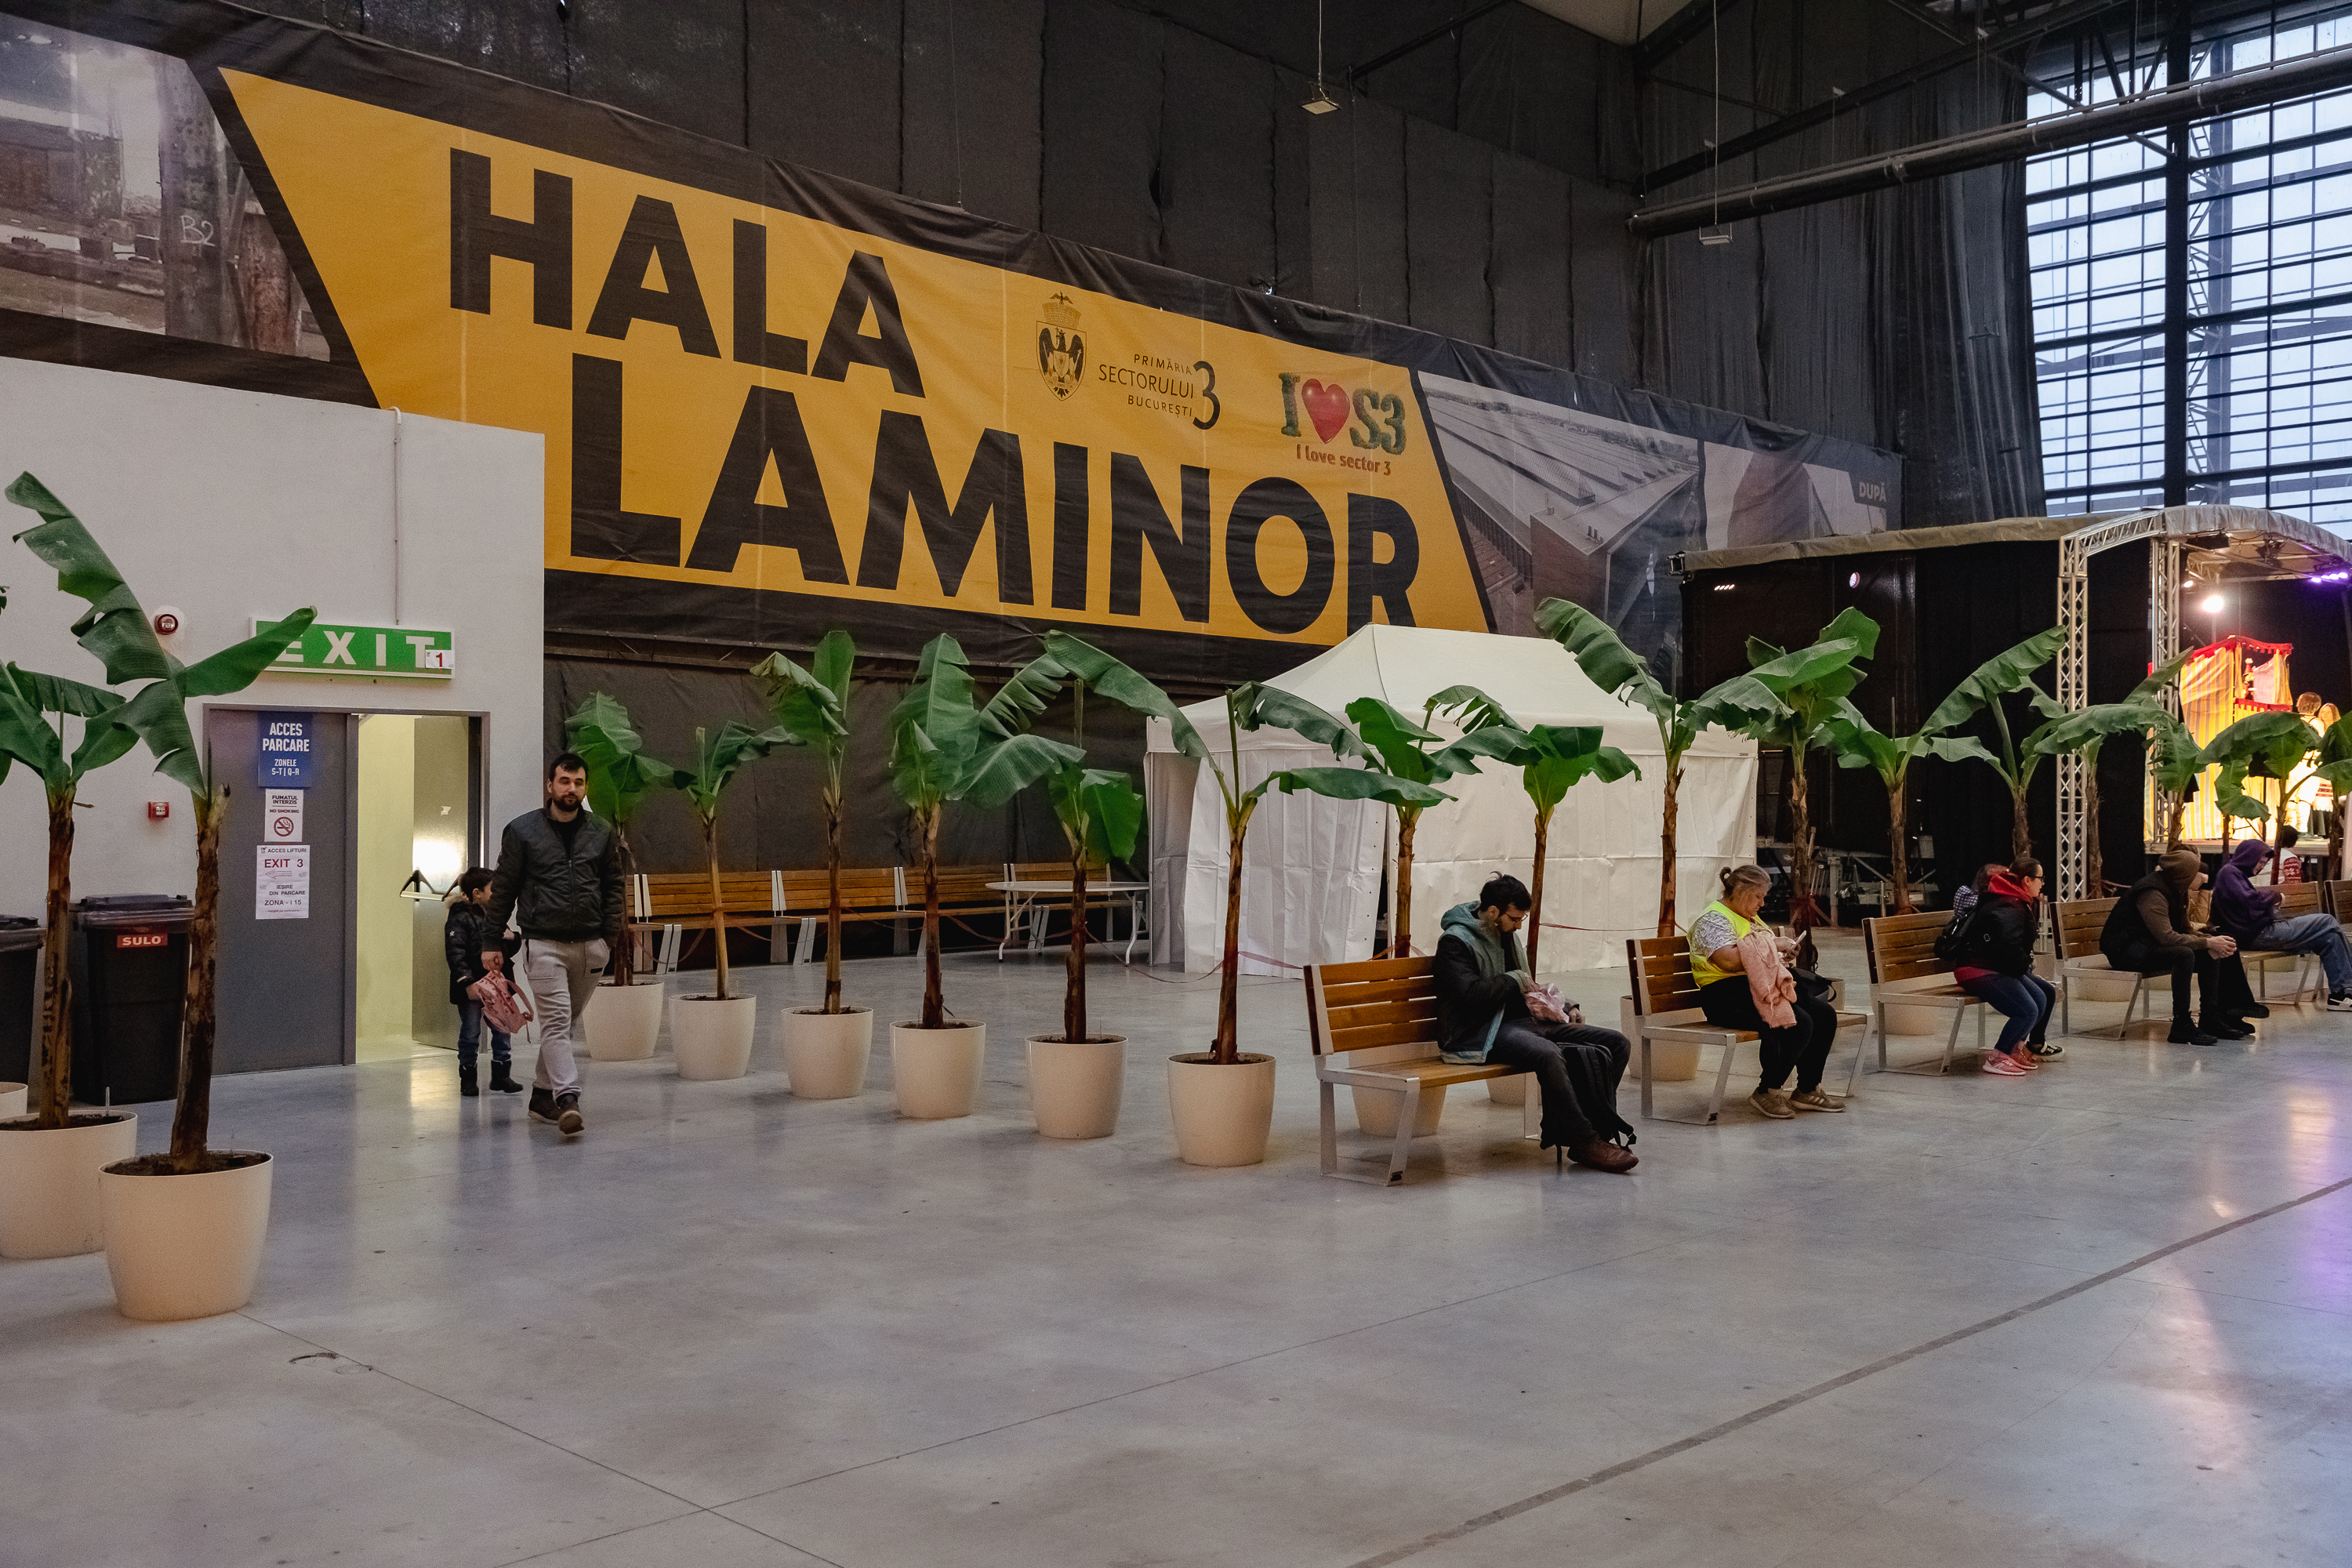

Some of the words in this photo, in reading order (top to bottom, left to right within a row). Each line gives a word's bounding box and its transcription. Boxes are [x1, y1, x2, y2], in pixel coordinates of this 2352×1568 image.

[180, 215, 216, 247] B2
[450, 147, 926, 399] HALA
[1134, 354, 1192, 376] PRIMĂRIA
[1098, 364, 1193, 399] SECTORULUI
[1192, 360, 1221, 430] 3
[1127, 394, 1192, 419] BUCUREȘTI
[1278, 372, 1302, 438] I
[1349, 388, 1406, 456] S3
[1297, 444, 1301, 459] I
[1305, 445, 1336, 465] love
[1339, 454, 1381, 473] sector
[1383, 460, 1392, 476] 3
[570, 352, 1420, 637] LAMINOR
[1859, 481, 1887, 503] DUPĂ
[435, 652, 443, 667] 1
[269, 722, 303, 736] ACCES
[262, 738, 310, 752] PARCARE
[274, 758, 297, 767] ZONELE
[264, 858, 291, 868] EXIT
[296, 858, 303, 868] 3
[122, 935, 162, 946] SULO
